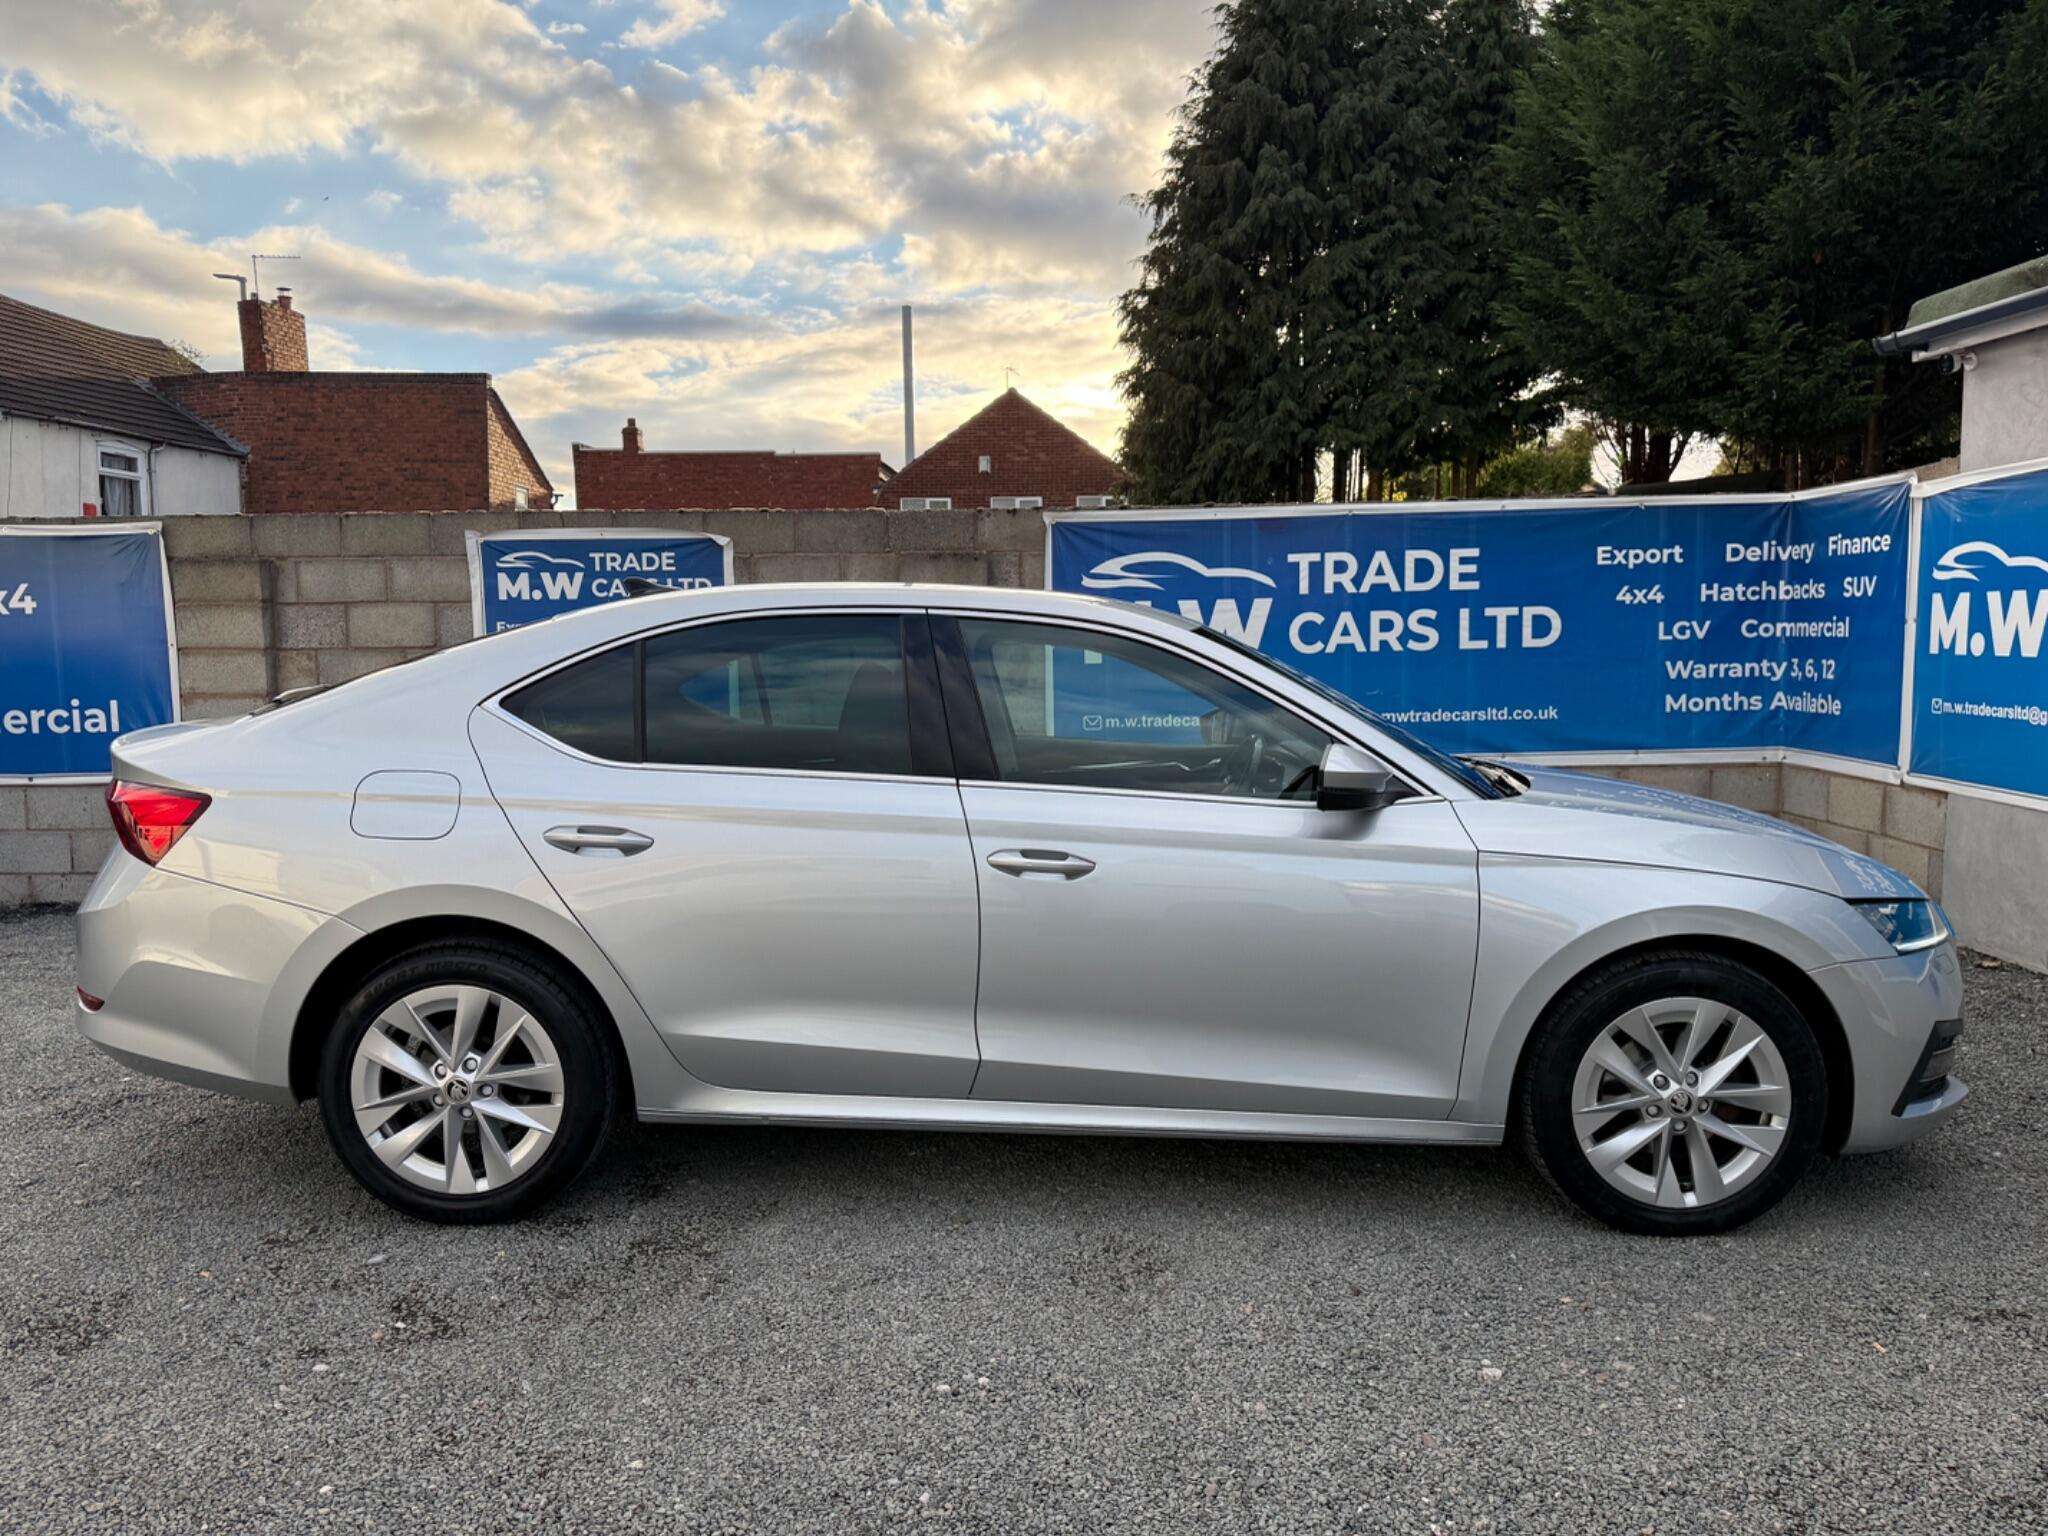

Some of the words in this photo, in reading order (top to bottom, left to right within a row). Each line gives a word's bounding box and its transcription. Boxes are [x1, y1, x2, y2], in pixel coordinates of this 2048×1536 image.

[588, 552, 676, 572] TRADE
[1596, 544, 1684, 569] Export
[1725, 540, 1815, 564] Delivery
[1827, 533, 1891, 556] Finance
[496, 571, 584, 601] M.W
[1287, 548, 1481, 595] TRADE
[591, 578, 658, 598] CA
[1615, 584, 1665, 605] 4x4
[1700, 579, 1825, 602] Hatchbacks
[1842, 575, 1877, 598] SUV
[1289, 608, 1440, 655] CARS
[1459, 605, 1562, 650] LTD
[1658, 620, 1711, 640] LGV
[1740, 616, 1850, 638] Commercial
[1929, 588, 2048, 658] M.W
[1665, 658, 1787, 681] Warranty
[1822, 658, 1835, 680] 12
[0, 698, 120, 735] ercial
[1664, 691, 1762, 713] Months
[1769, 691, 1841, 715] Available
